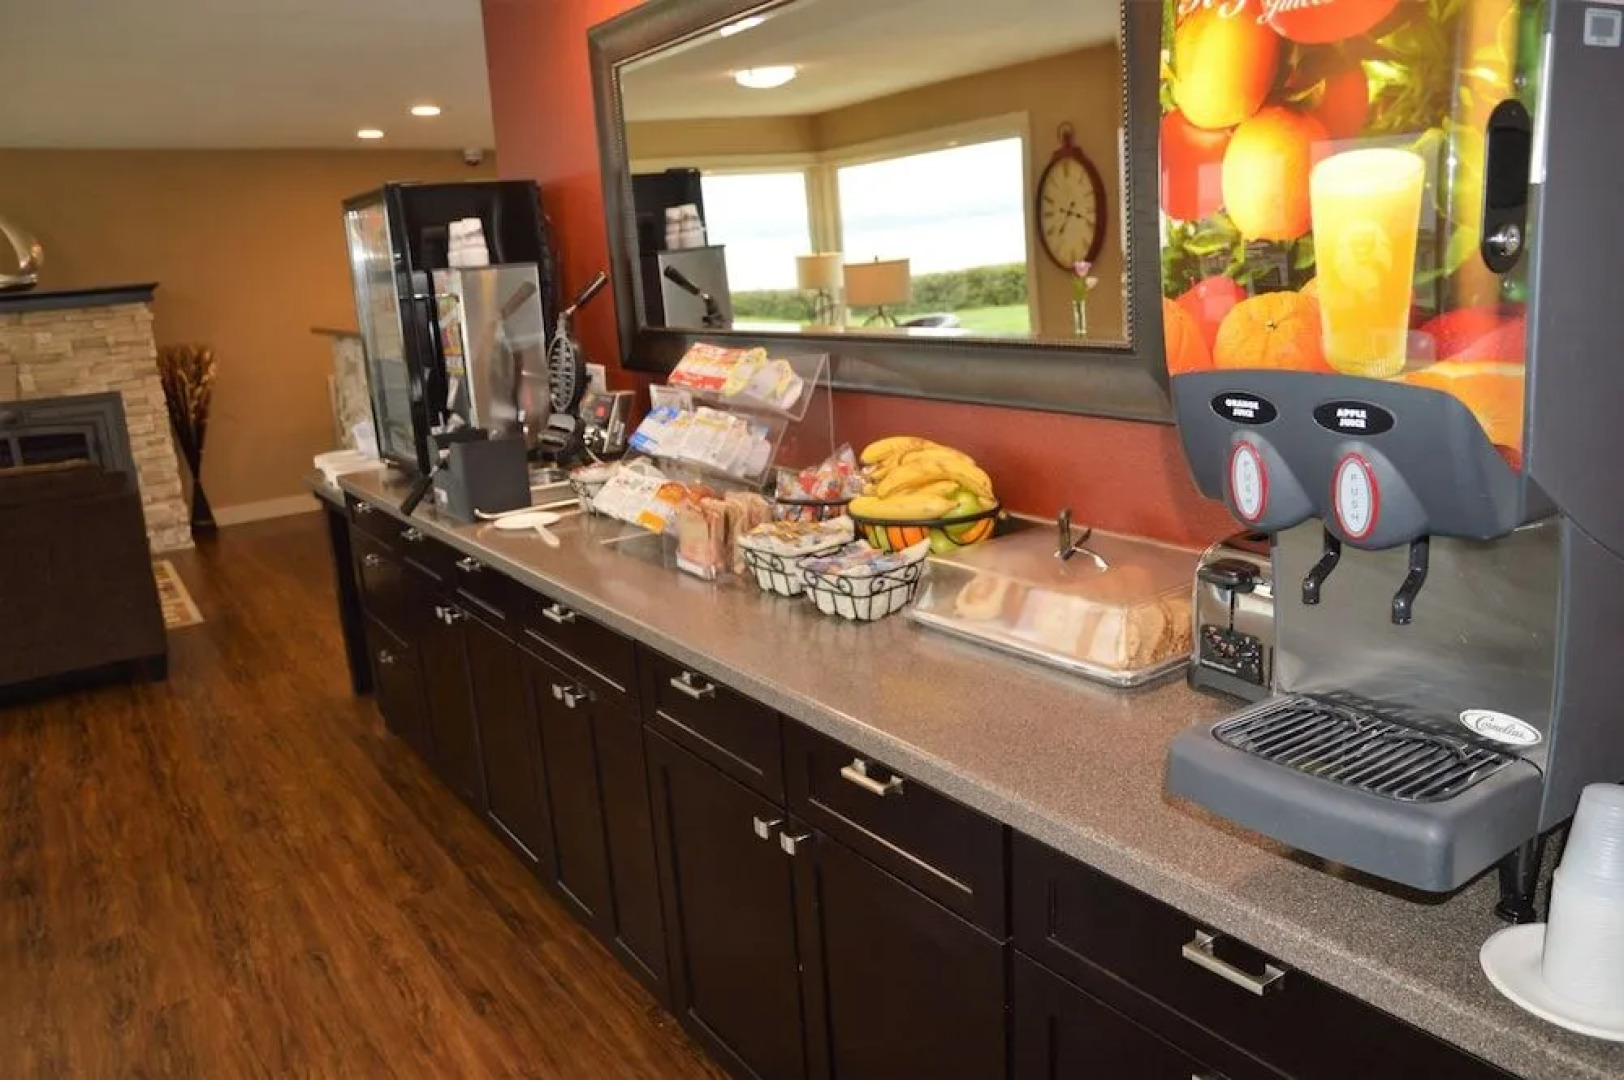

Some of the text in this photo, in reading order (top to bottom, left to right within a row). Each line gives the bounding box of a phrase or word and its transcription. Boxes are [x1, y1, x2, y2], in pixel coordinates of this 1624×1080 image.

[1225, 398, 1260, 410] ORANGE
[1232, 408, 1255, 418] JUICE
[1336, 408, 1367, 418] APPLE
[1339, 418, 1367, 428] JUICE
[1350, 473, 1359, 522] PUSH
